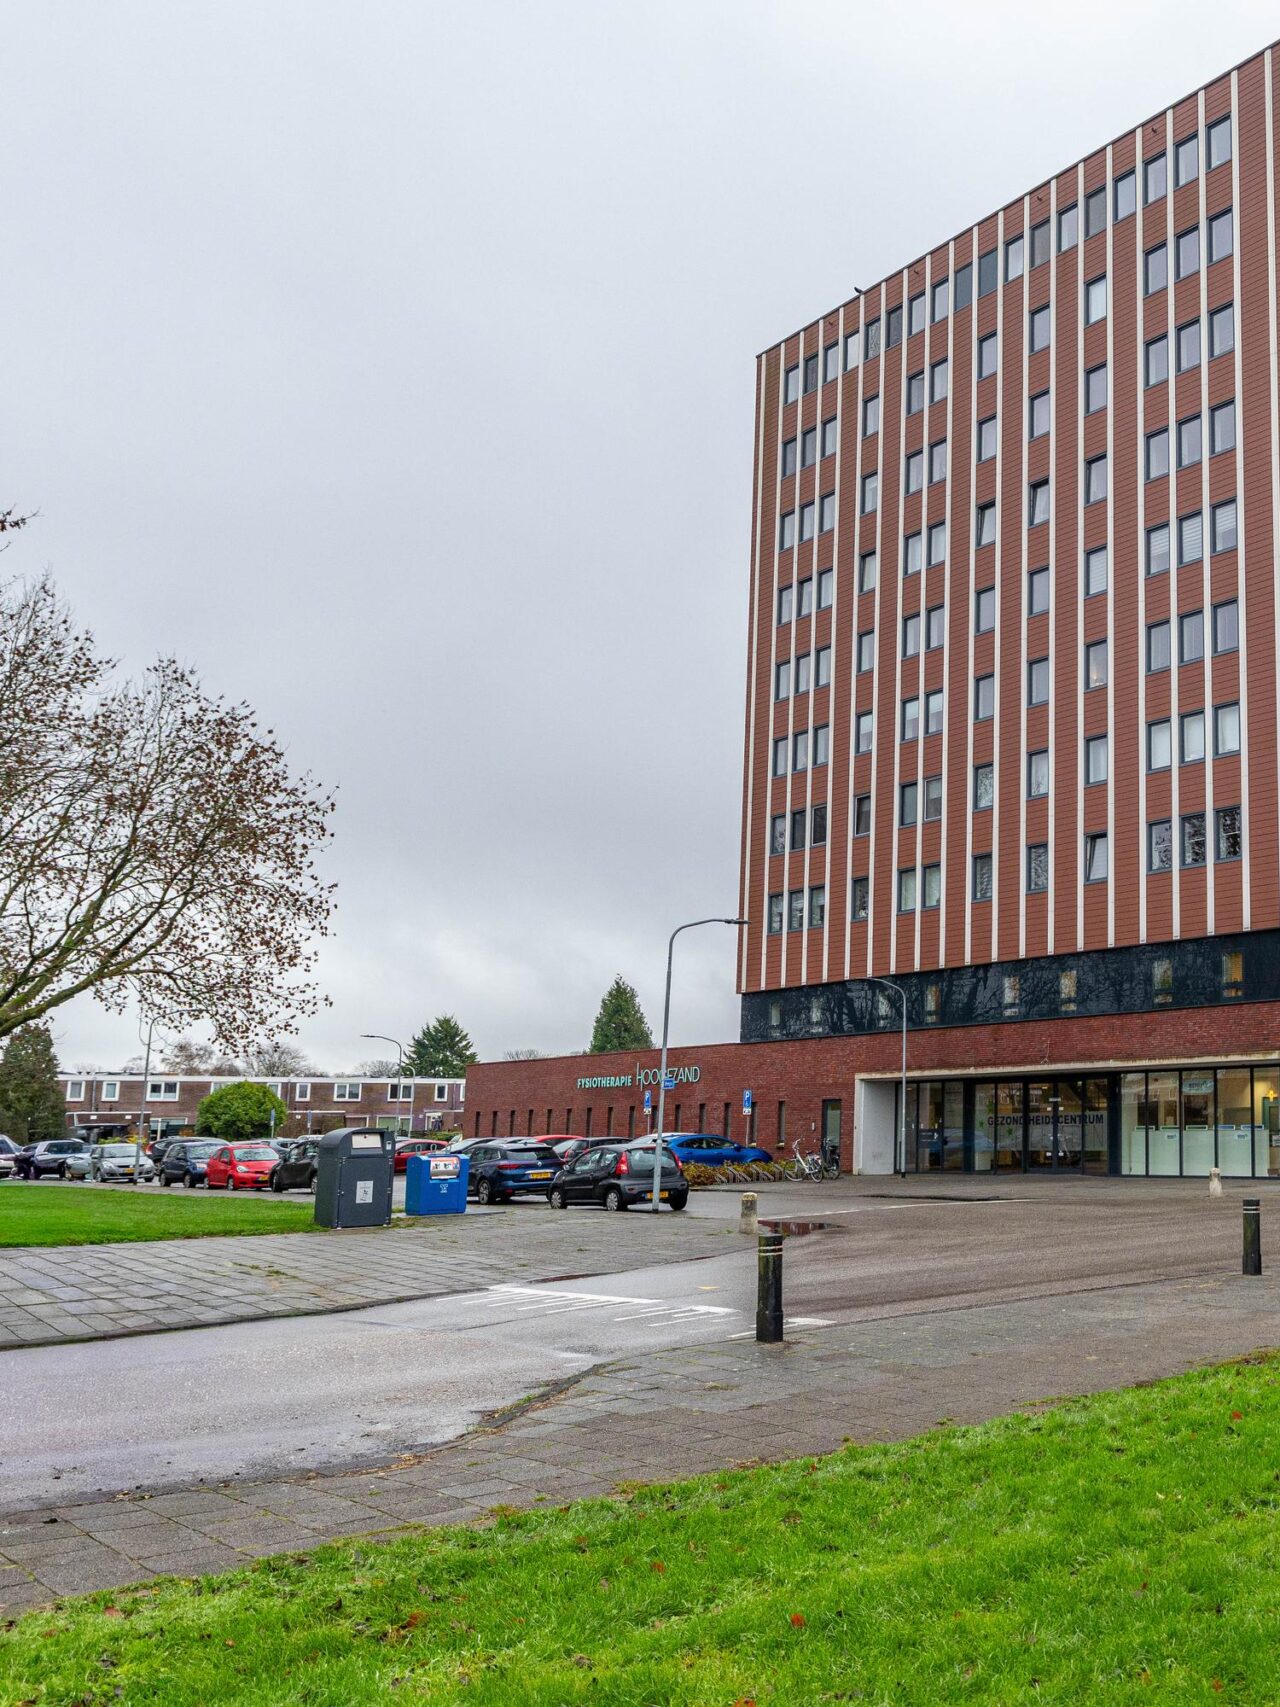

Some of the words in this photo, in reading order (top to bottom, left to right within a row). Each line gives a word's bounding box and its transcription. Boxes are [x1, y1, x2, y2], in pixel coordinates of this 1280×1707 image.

[577, 1075, 632, 1089] FYSIOTHERAPIE
[636, 1062, 700, 1091] HOOEZAND
[987, 1114, 1104, 1126] GEZONDHEIDCENTRUM
